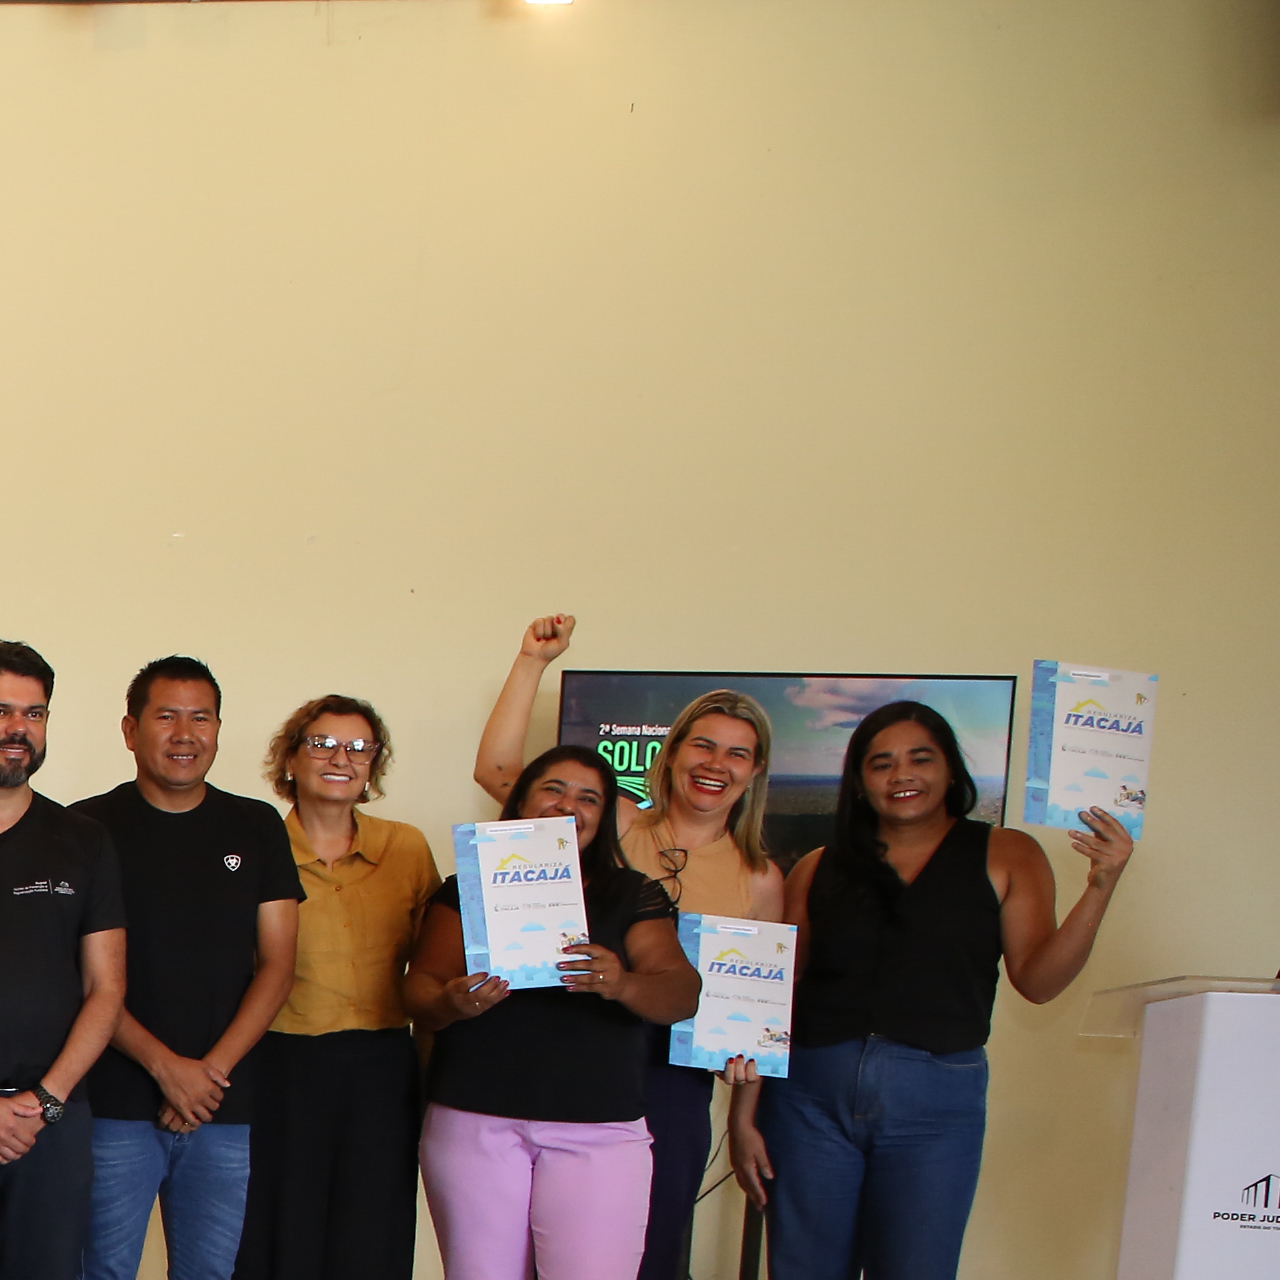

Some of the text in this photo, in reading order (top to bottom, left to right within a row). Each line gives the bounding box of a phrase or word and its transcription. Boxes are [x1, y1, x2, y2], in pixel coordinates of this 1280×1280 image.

[611, 724, 641, 735] Semana
[1064, 713, 1144, 735] ITACAJÁ
[492, 864, 571, 884] ITACAJÁ
[708, 961, 785, 981] ITACAJÁ
[1213, 1212, 1256, 1222] PODER
